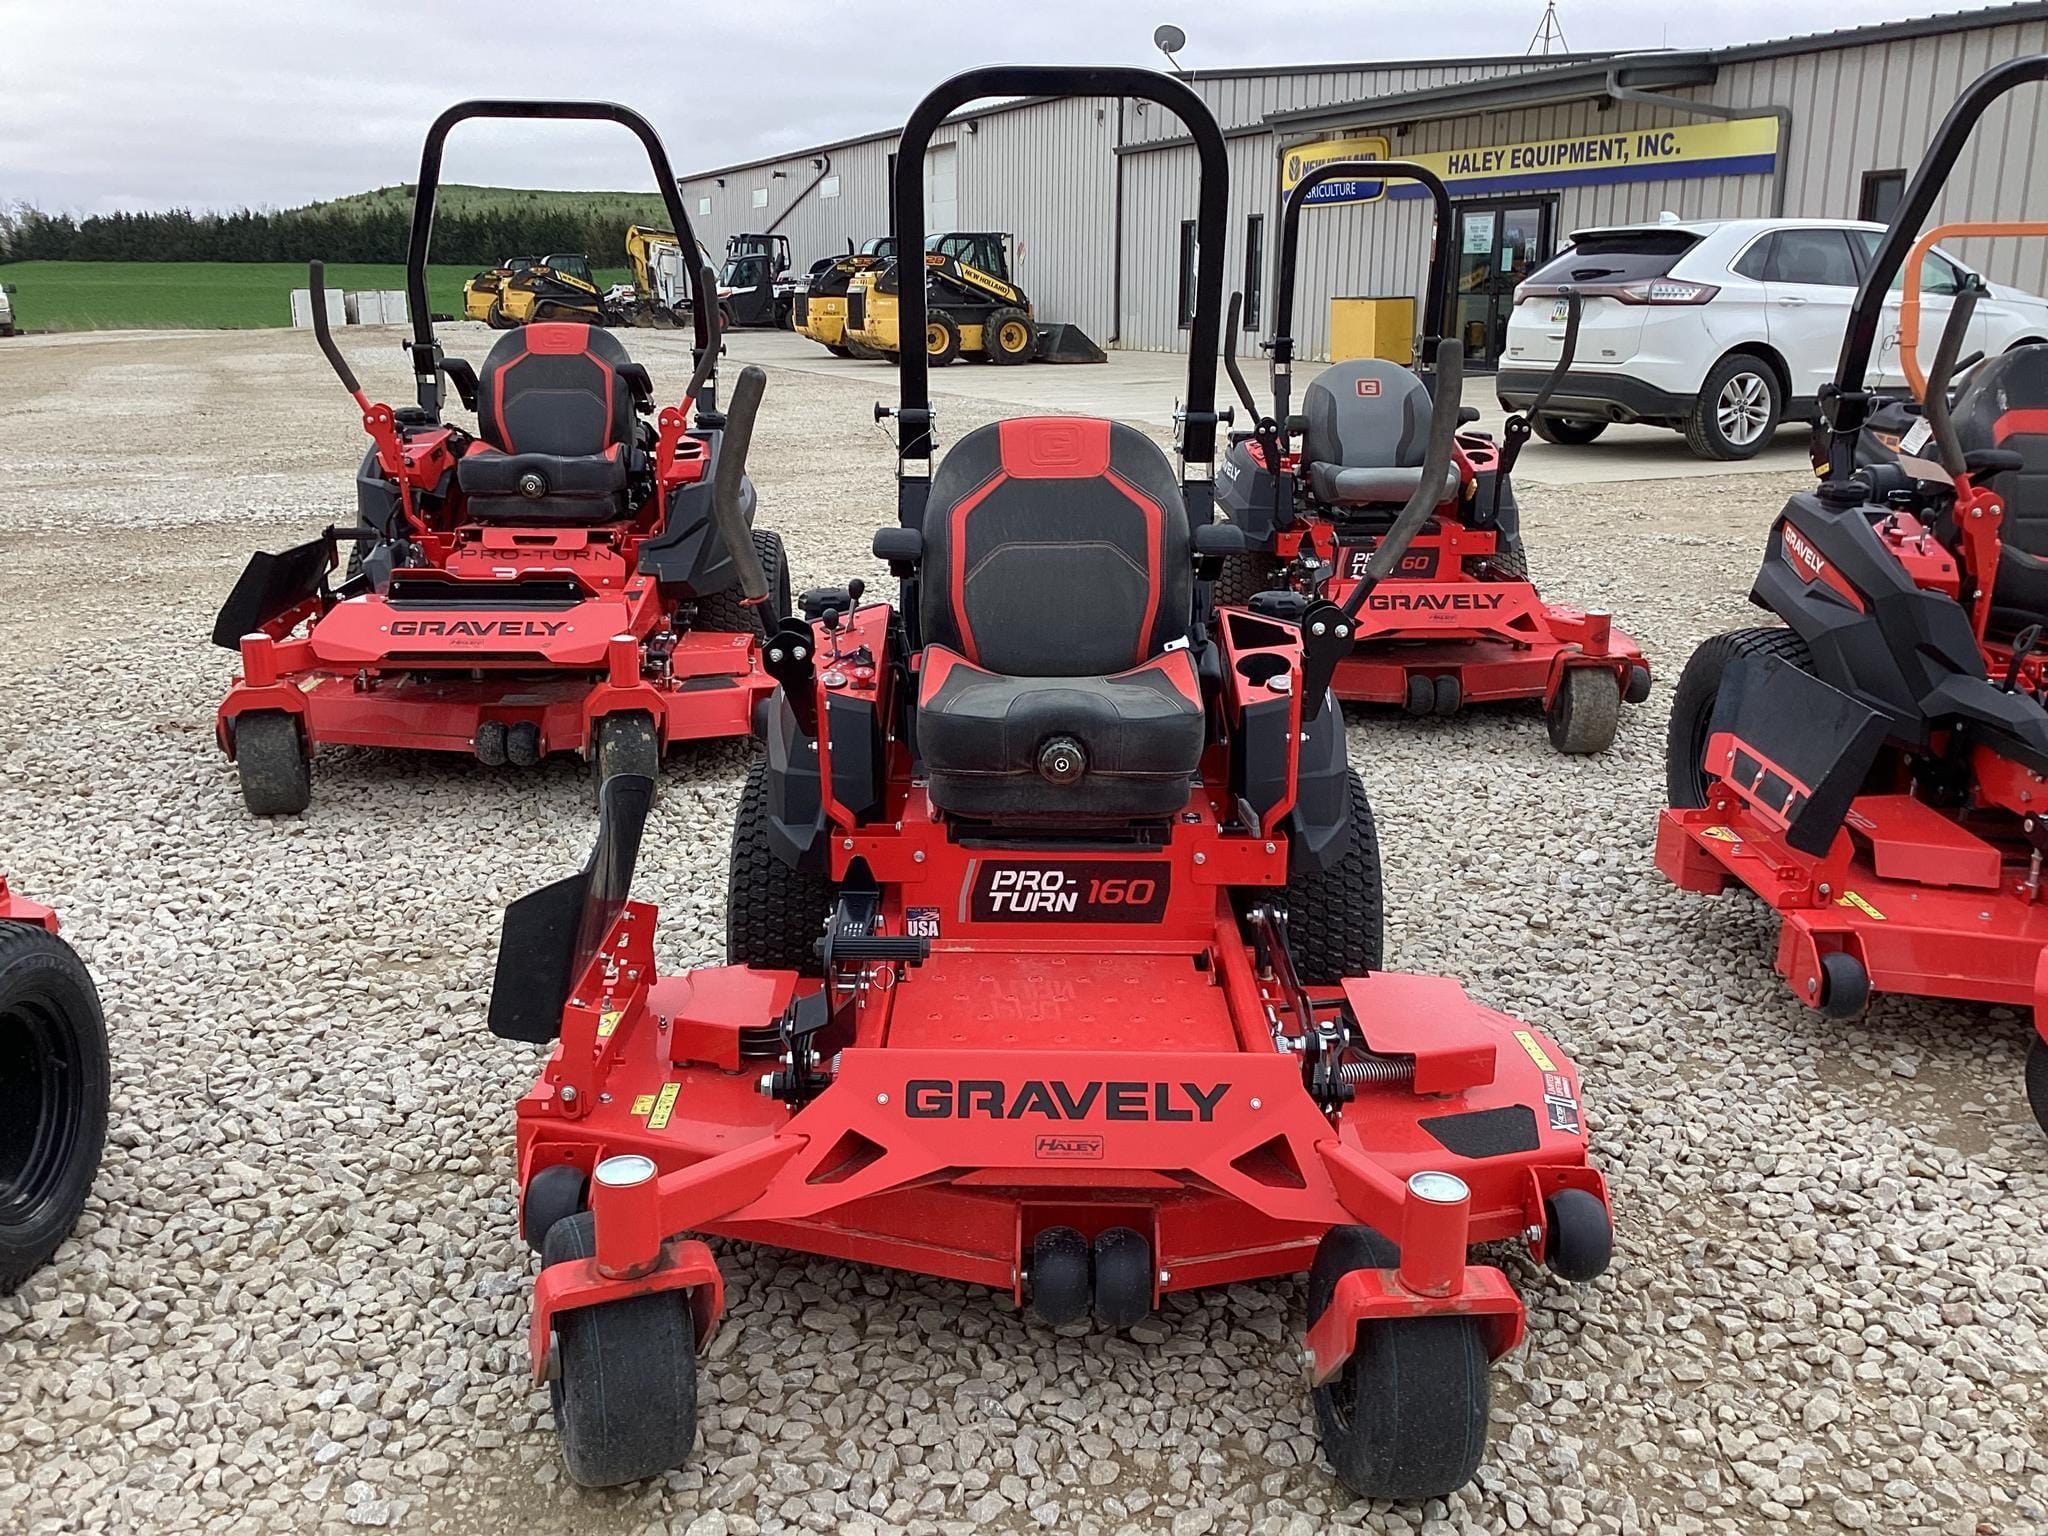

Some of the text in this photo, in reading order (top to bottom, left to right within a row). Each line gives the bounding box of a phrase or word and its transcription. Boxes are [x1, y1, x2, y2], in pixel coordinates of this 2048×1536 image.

[1448, 132, 1681, 175] HALEY EQUIPMENT, INC.
[1785, 526, 1825, 573] GRAVELY
[1368, 593, 1505, 610] GRAVELY
[390, 621, 568, 636] GRAVELY
[990, 870, 1156, 904] PRO- 160
[988, 892, 1079, 912] TURN
[908, 920, 939, 937] USA
[905, 1079, 1233, 1122] GRAVELY
[1038, 1138, 1100, 1152] HALEY
